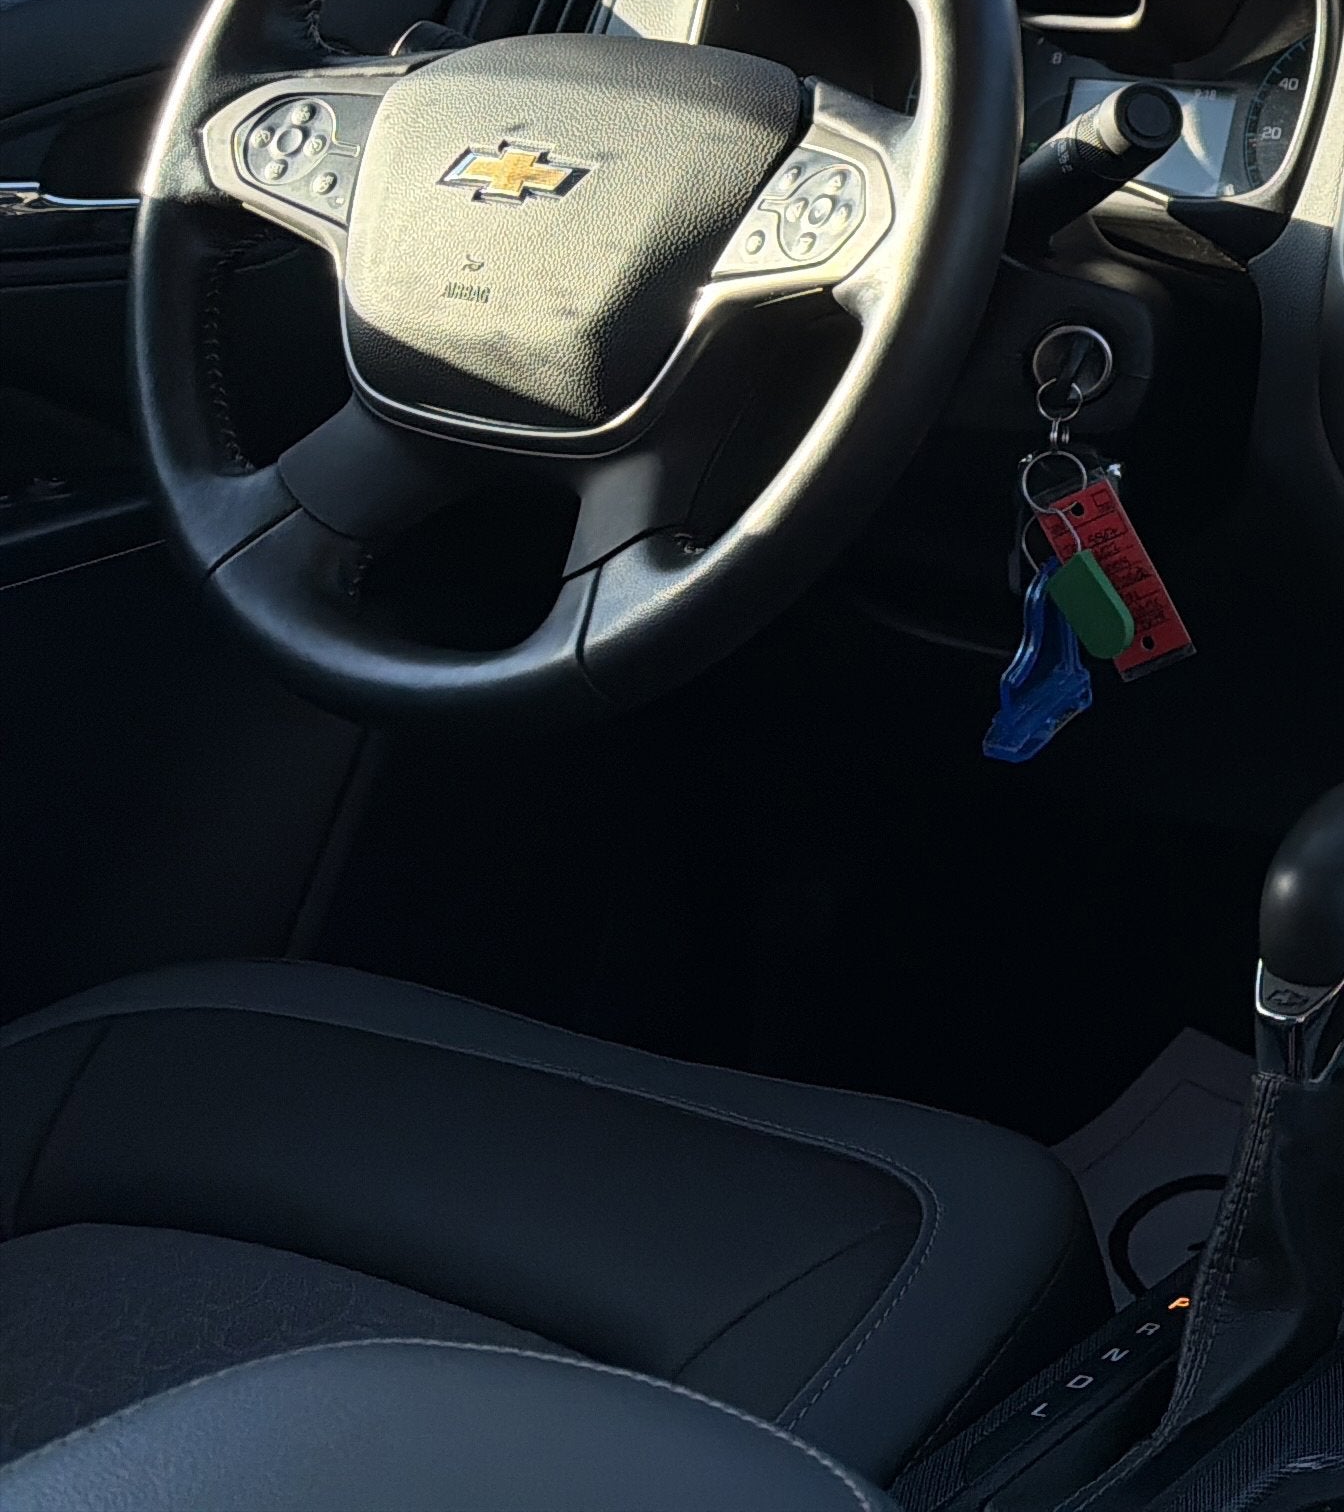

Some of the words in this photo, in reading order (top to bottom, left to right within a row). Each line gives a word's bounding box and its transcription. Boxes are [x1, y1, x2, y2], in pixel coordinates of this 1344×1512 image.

[1278, 77, 1300, 91] 40
[1261, 125, 1282, 140] 20
[441, 281, 491, 304] AIRBAG
[1167, 1296, 1191, 1310] P
[1135, 1322, 1161, 1336] R
[1101, 1347, 1130, 1362] N
[1066, 1374, 1094, 1389] D
[1031, 1402, 1049, 1418] L
